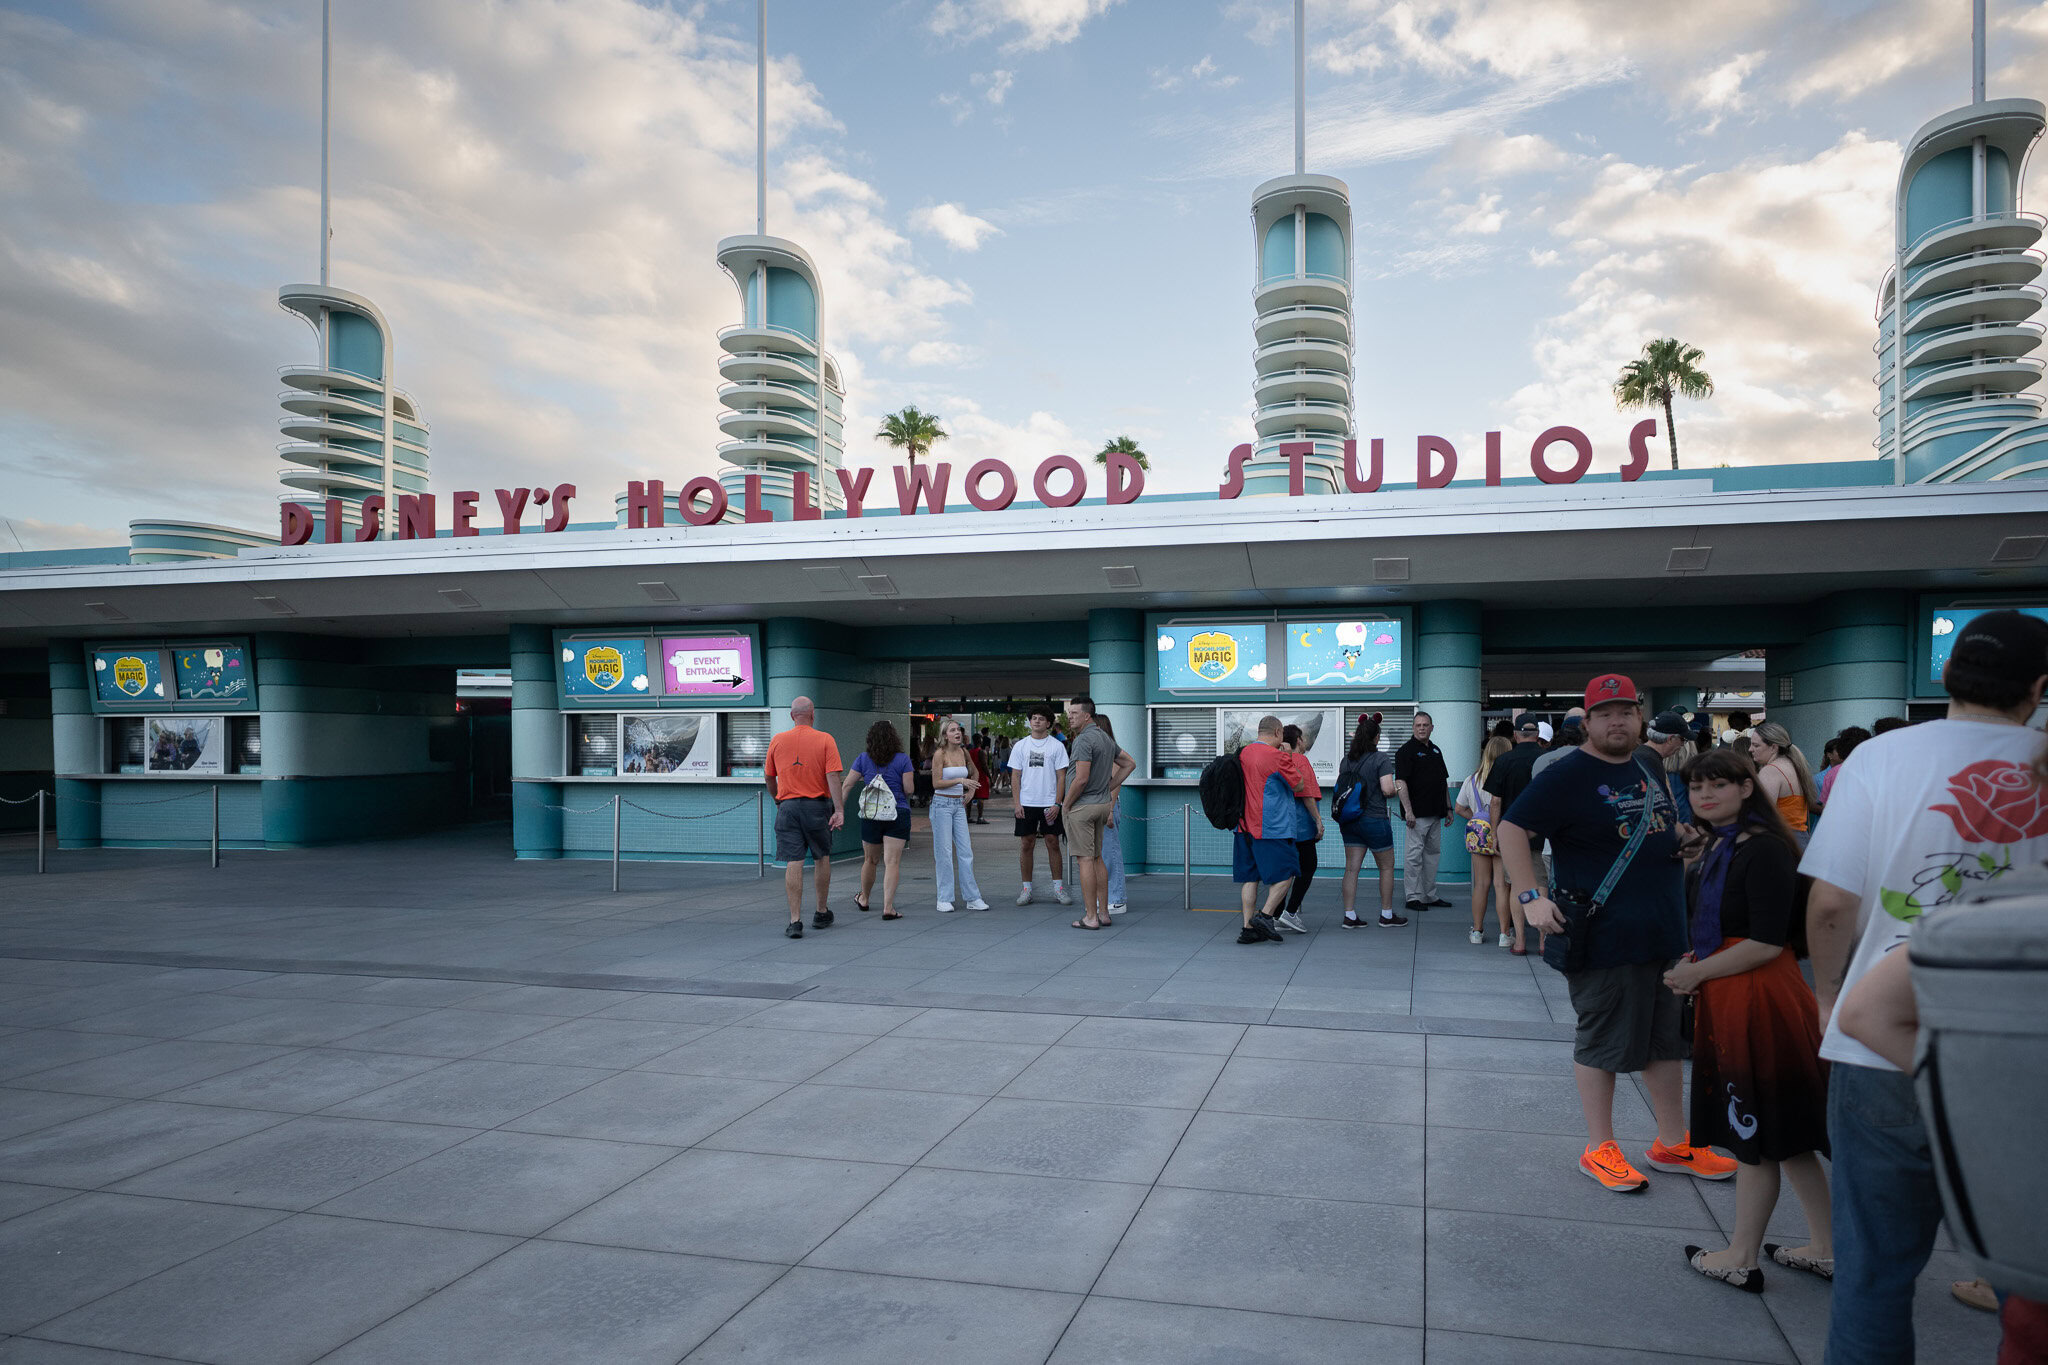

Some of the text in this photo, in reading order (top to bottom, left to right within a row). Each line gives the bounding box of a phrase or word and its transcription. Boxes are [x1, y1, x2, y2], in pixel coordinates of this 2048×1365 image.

[281, 418, 1657, 546] DISNEY'S HOLLYWOOD STUDIOS
[693, 657, 721, 665] EVENT
[1194, 651, 1232, 663] MAGIC
[589, 663, 619, 674] MAGIC
[685, 667, 731, 676] ENTRANCE
[118, 672, 144, 681] MAGIC
